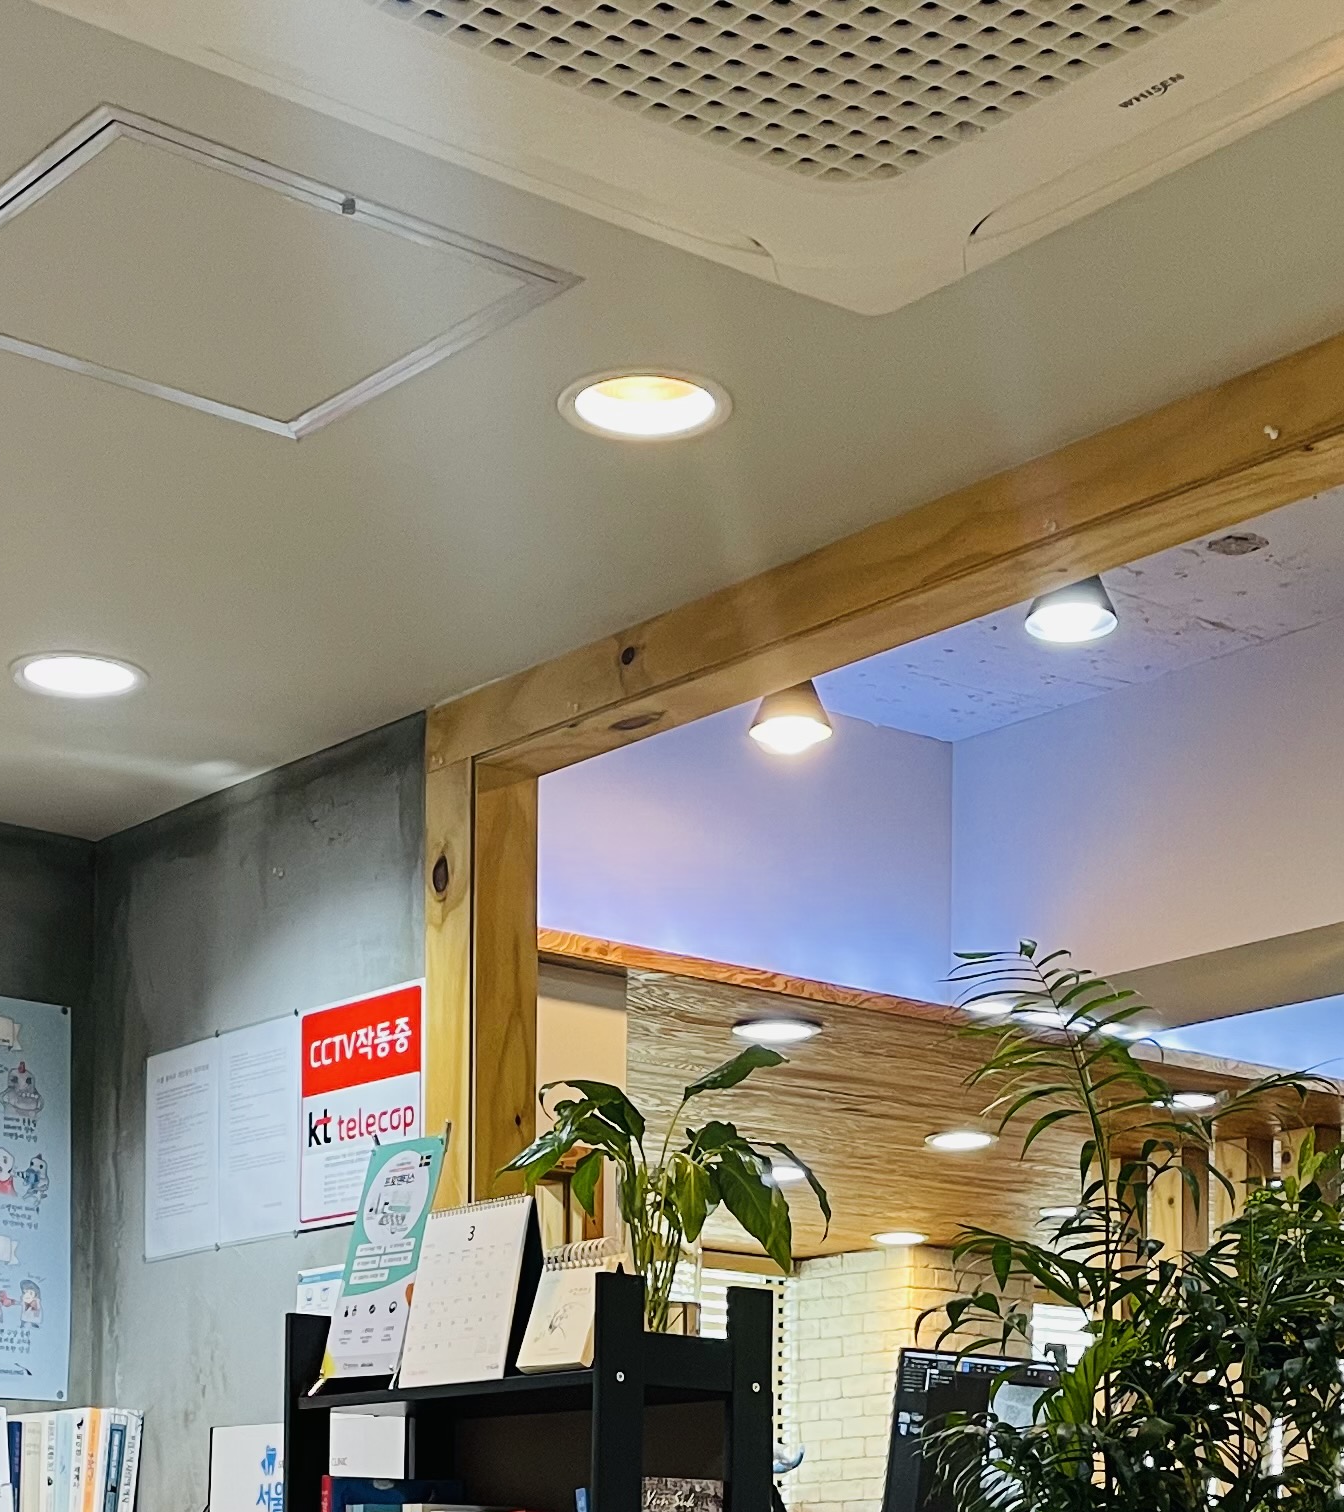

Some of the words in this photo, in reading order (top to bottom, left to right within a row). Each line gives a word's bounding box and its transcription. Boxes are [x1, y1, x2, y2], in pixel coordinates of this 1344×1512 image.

[1116, 73, 1185, 109] WHISEN
[308, 1016, 414, 1069] CCTV작동중
[307, 1107, 333, 1149] kt
[336, 1103, 416, 1143] telecop
[467, 1225, 476, 1242] 3
